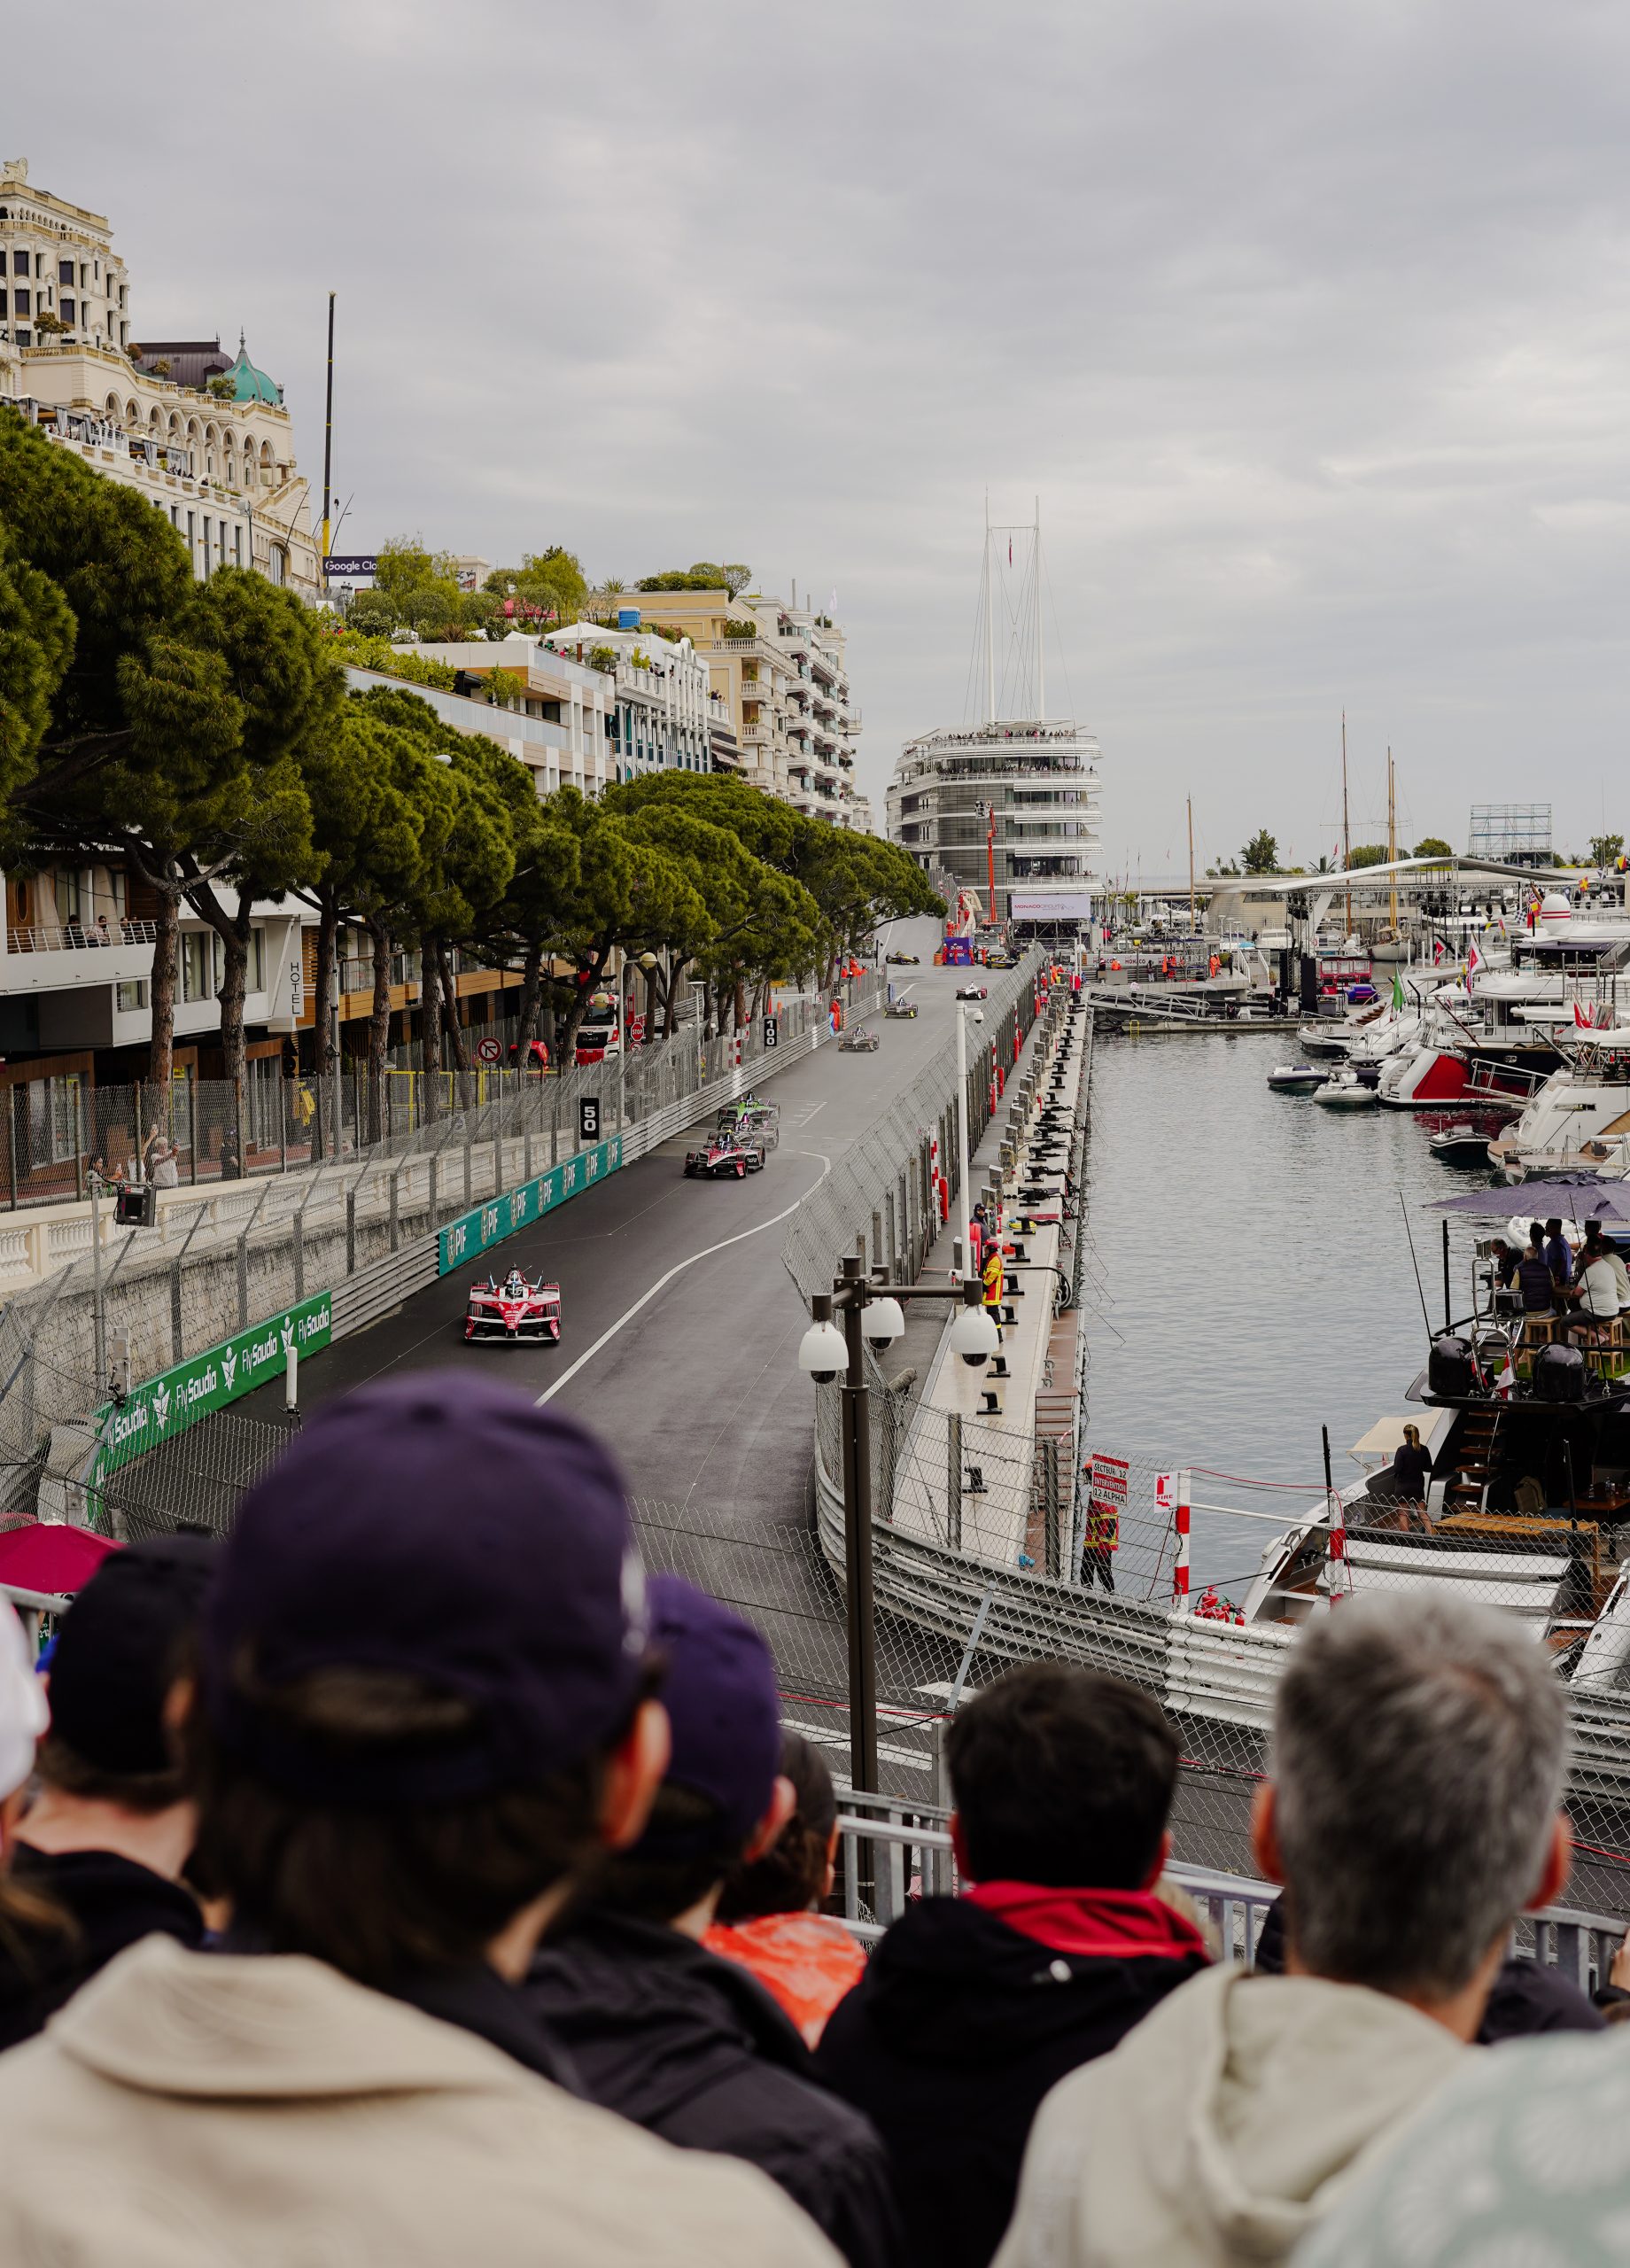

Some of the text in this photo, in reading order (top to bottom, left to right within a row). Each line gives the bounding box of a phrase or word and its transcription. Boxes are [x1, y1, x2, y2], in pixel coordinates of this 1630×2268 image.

[325, 561, 377, 573] Google Clo
[291, 962, 300, 1014] HOTEL
[766, 1020, 775, 1045] 100
[584, 1106, 596, 1131] 50
[517, 1191, 526, 1218] PIF
[543, 1178, 553, 1206] PIF
[488, 1207, 499, 1237] PIF
[455, 1224, 467, 1256] PIF
[1094, 1464, 1127, 1479] SECTEUR 12
[1094, 1477, 1126, 1492] INTERVENTION
[1094, 1488, 1125, 1503] 12 ALPHA
